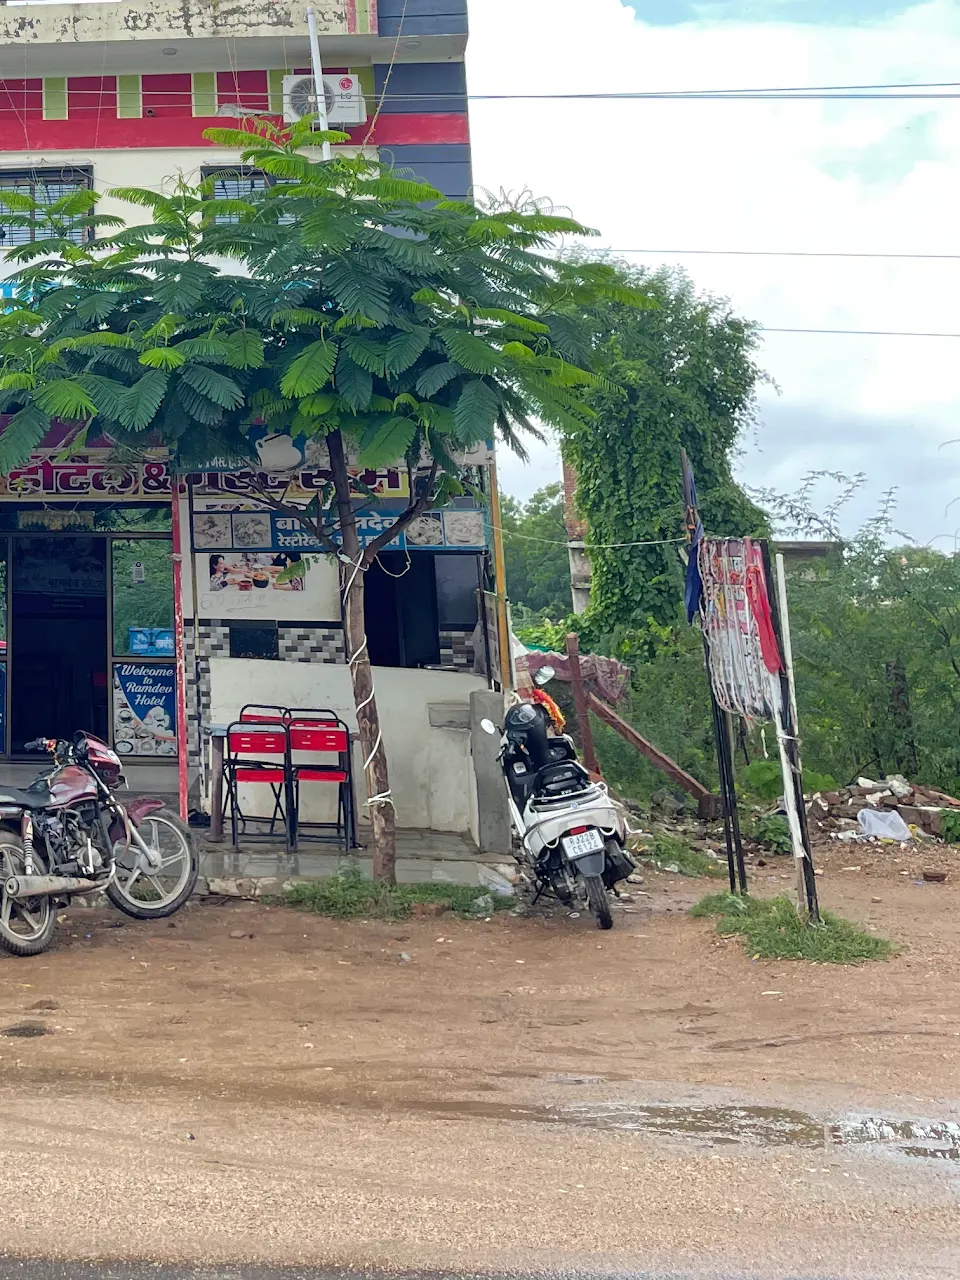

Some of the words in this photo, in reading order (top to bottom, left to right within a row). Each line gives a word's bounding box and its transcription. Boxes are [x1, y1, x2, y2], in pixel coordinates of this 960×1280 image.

[142, 463, 172, 493] &
[121, 665, 174, 677] Welcome
[142, 676, 153, 685] to
[126, 682, 173, 694] Ramdev
[135, 694, 166, 706] Hotel
